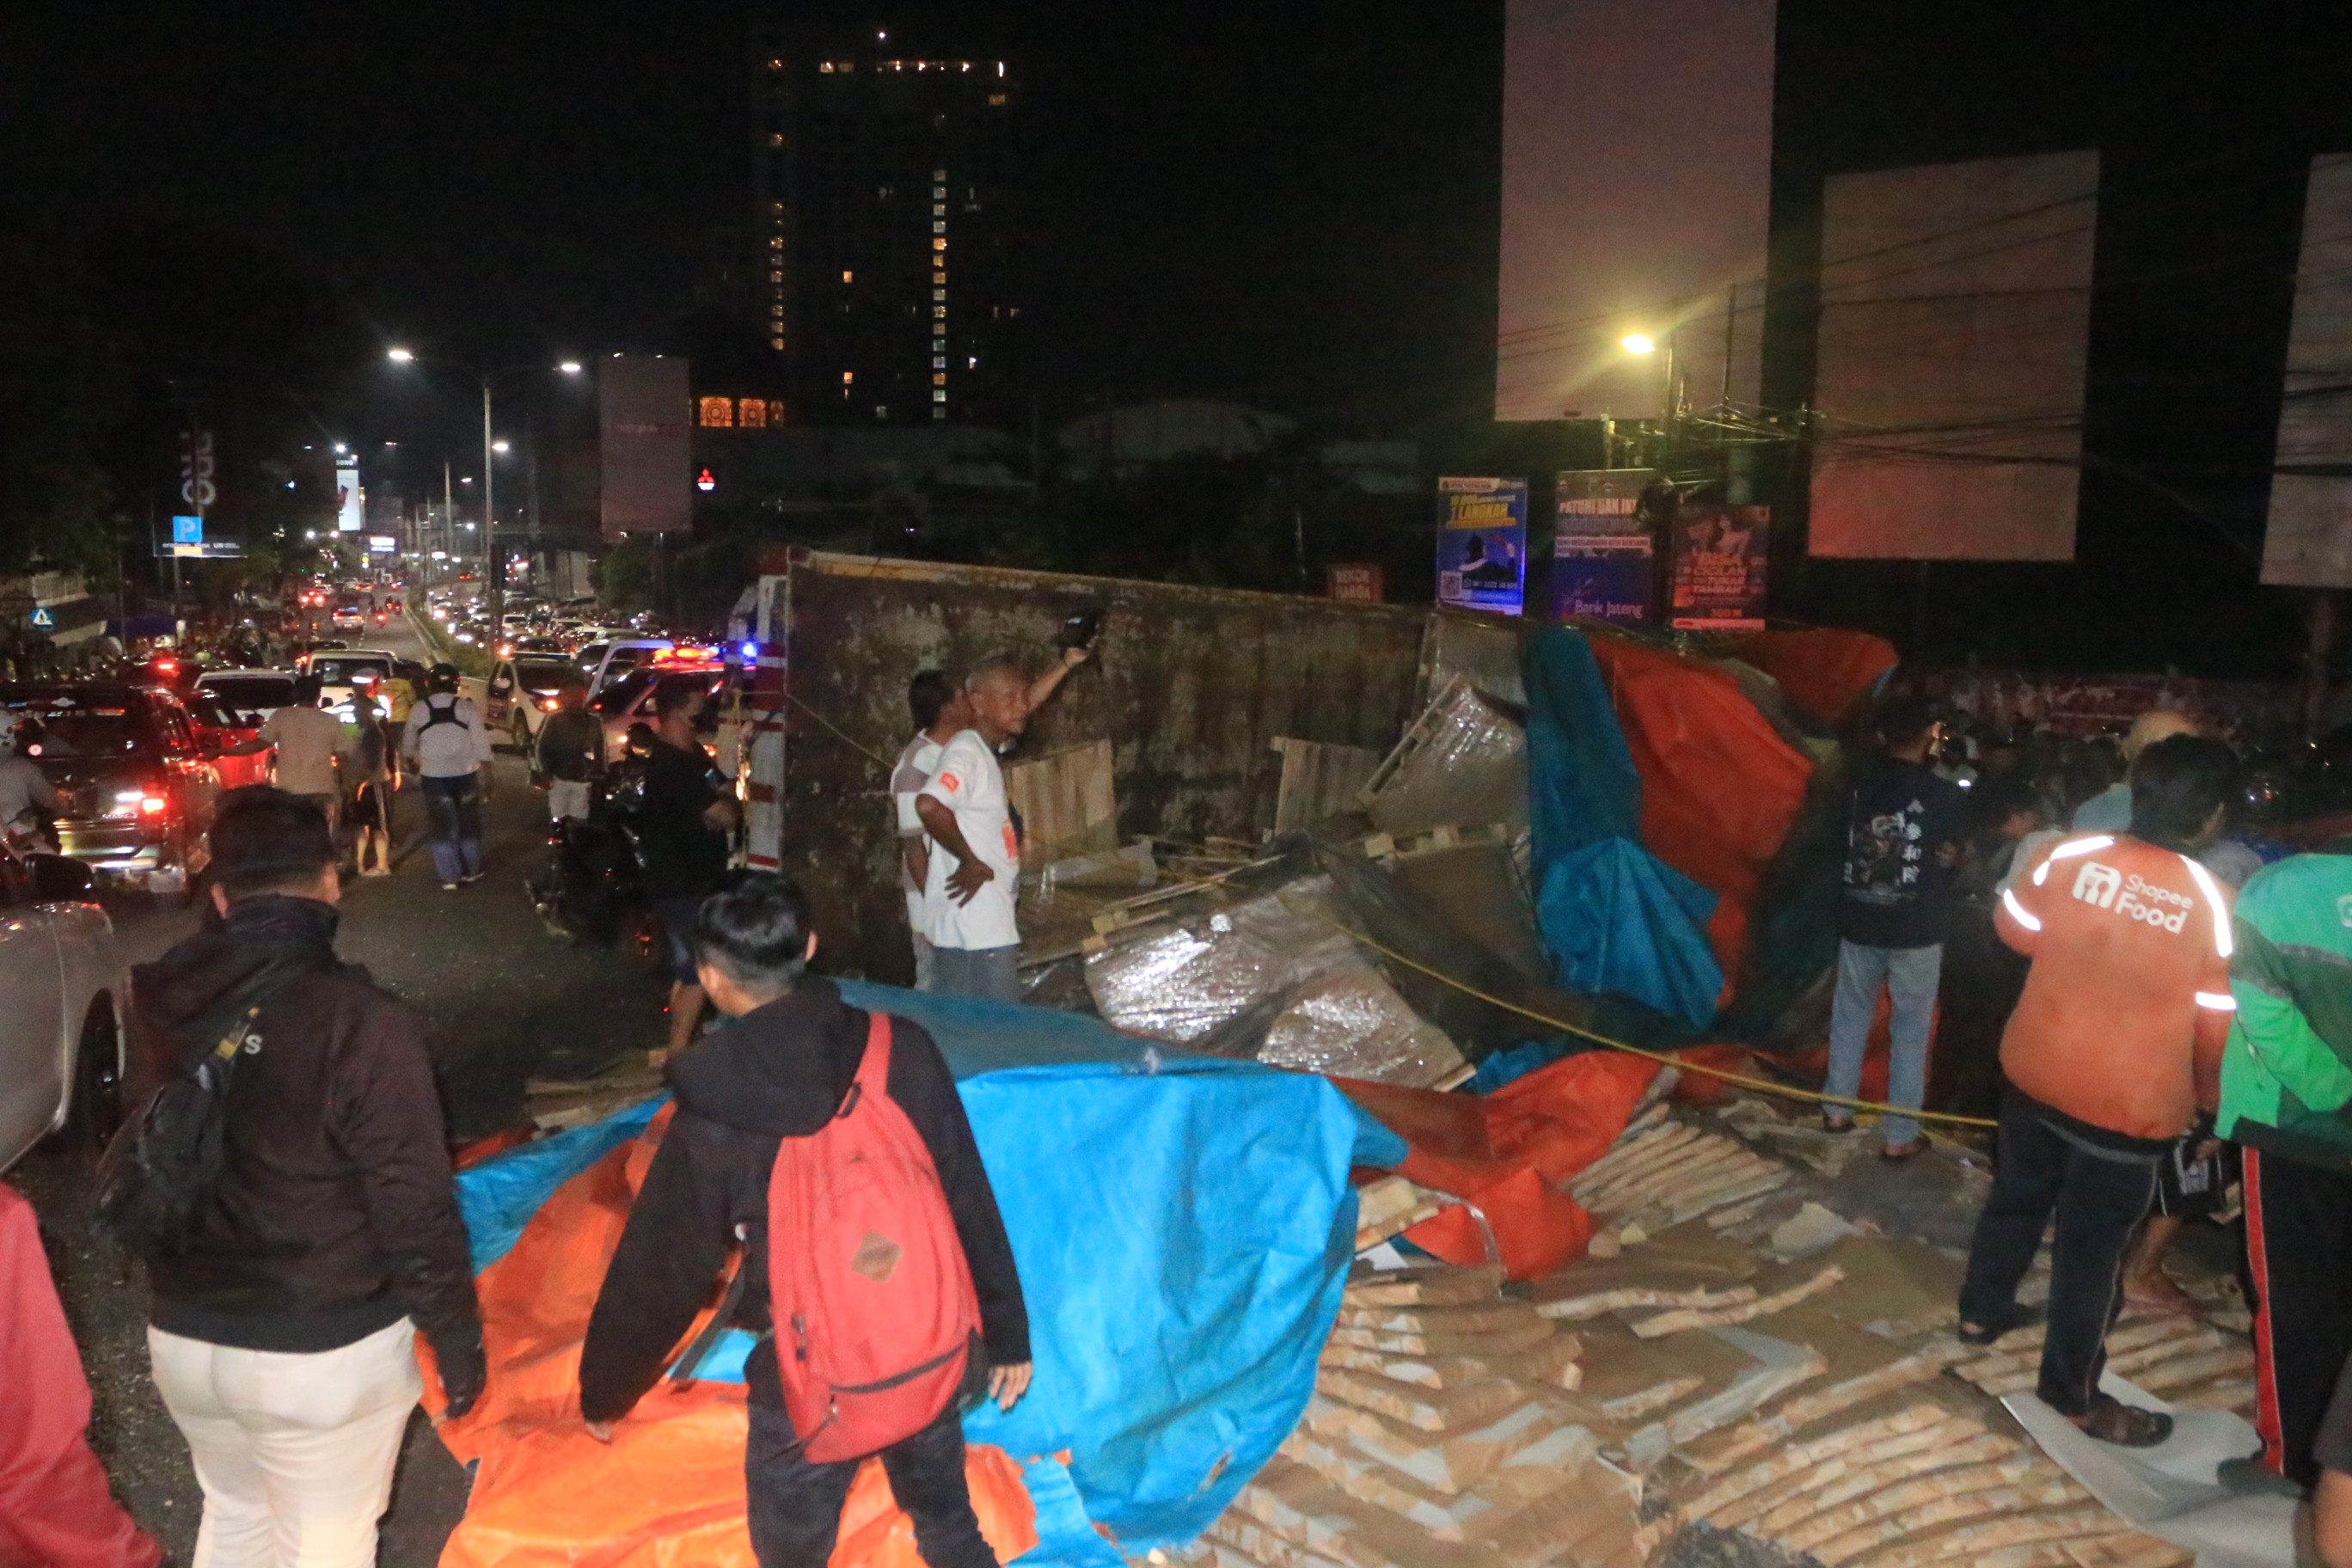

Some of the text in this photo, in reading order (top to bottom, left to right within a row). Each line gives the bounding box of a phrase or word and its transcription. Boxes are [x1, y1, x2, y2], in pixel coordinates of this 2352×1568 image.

[181, 520, 195, 539] P
[1575, 599, 1644, 620] Bank Jateng
[2127, 874, 2194, 910] Shopee
[2114, 892, 2189, 934] Food
